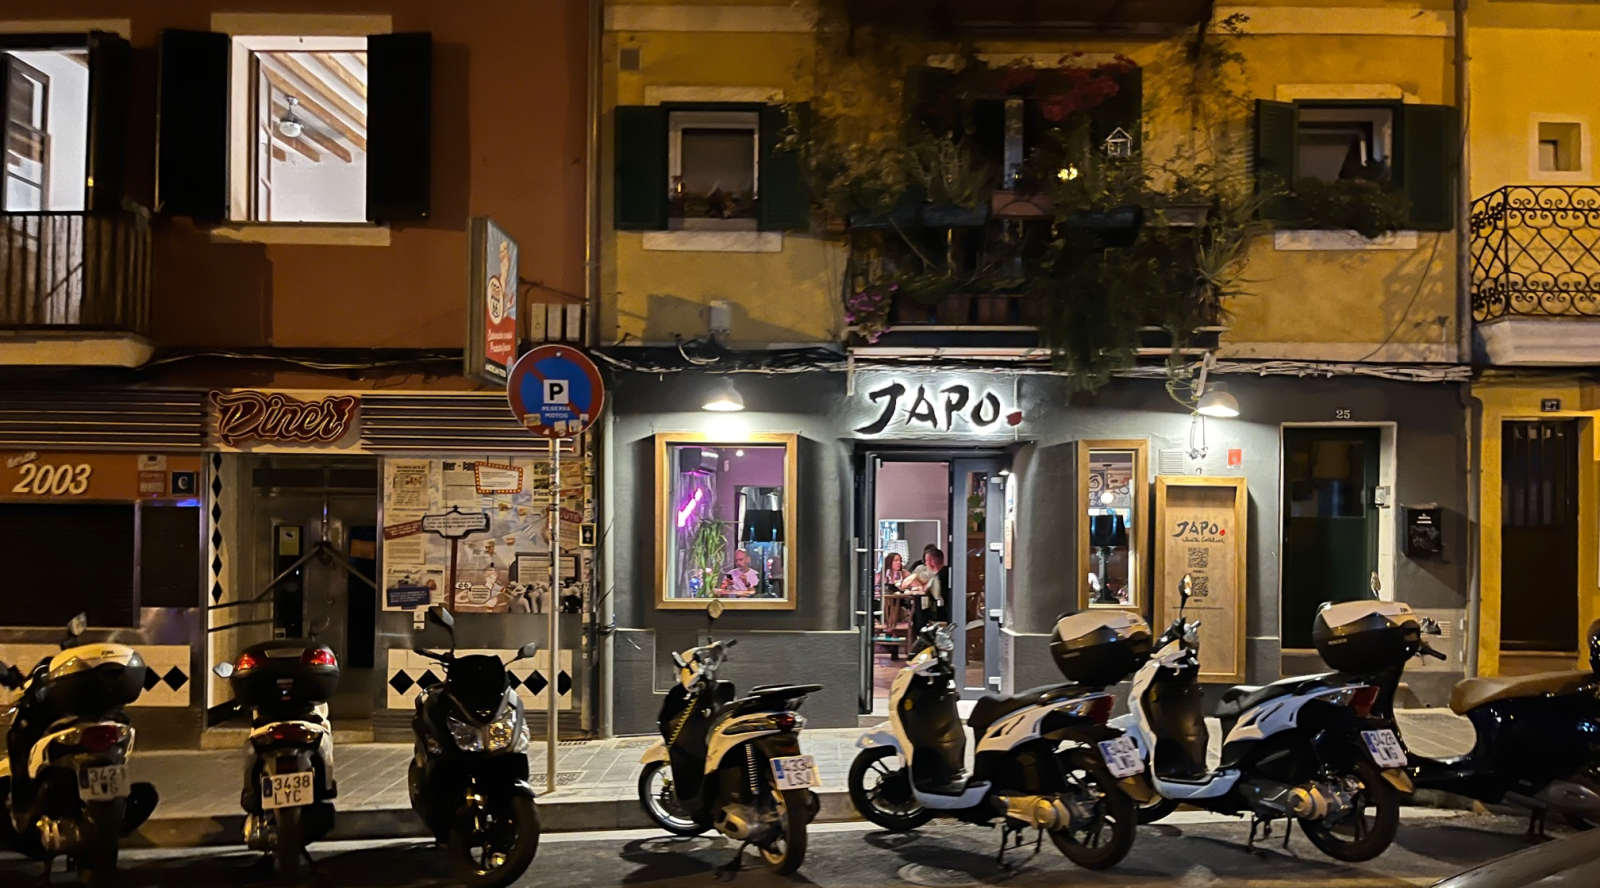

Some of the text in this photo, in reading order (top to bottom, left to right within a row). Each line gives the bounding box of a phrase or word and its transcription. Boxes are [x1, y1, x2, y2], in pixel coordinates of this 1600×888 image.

[549, 382, 564, 401] P
[209, 390, 355, 446] Diner
[1335, 408, 1351, 419] 25
[11, 463, 92, 495] 2003
[273, 775, 311, 791] 3438
[274, 789, 302, 805] LYC
